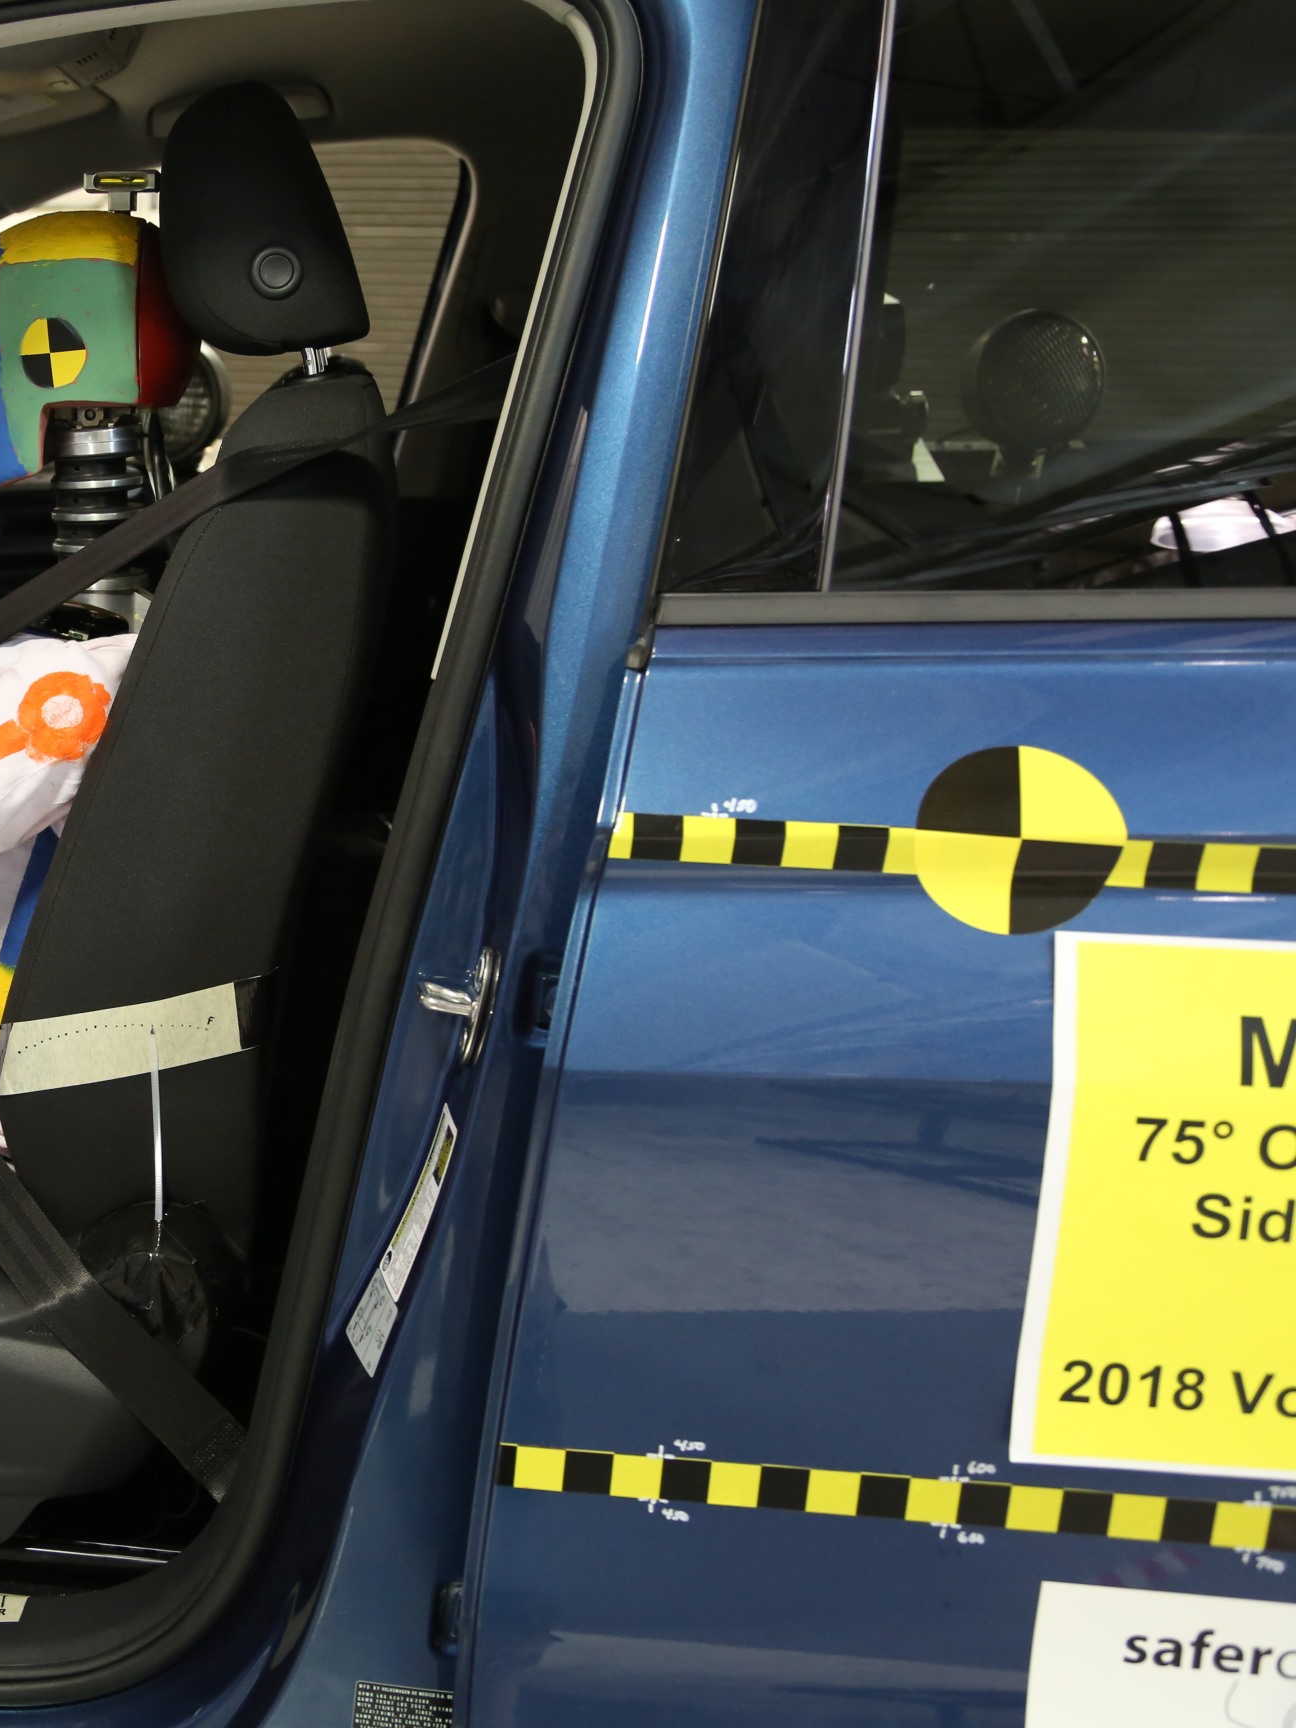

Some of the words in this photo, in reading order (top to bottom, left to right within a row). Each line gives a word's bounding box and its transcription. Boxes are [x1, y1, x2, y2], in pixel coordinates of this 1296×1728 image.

[207, 1016, 215, 1025] F
[1240, 1015, 1296, 1088] M
[1136, 1117, 1234, 1165] 75°
[1191, 1193, 1296, 1243] Sid
[1059, 1359, 1206, 1411] 2018
[1232, 1370, 1296, 1419] Vo
